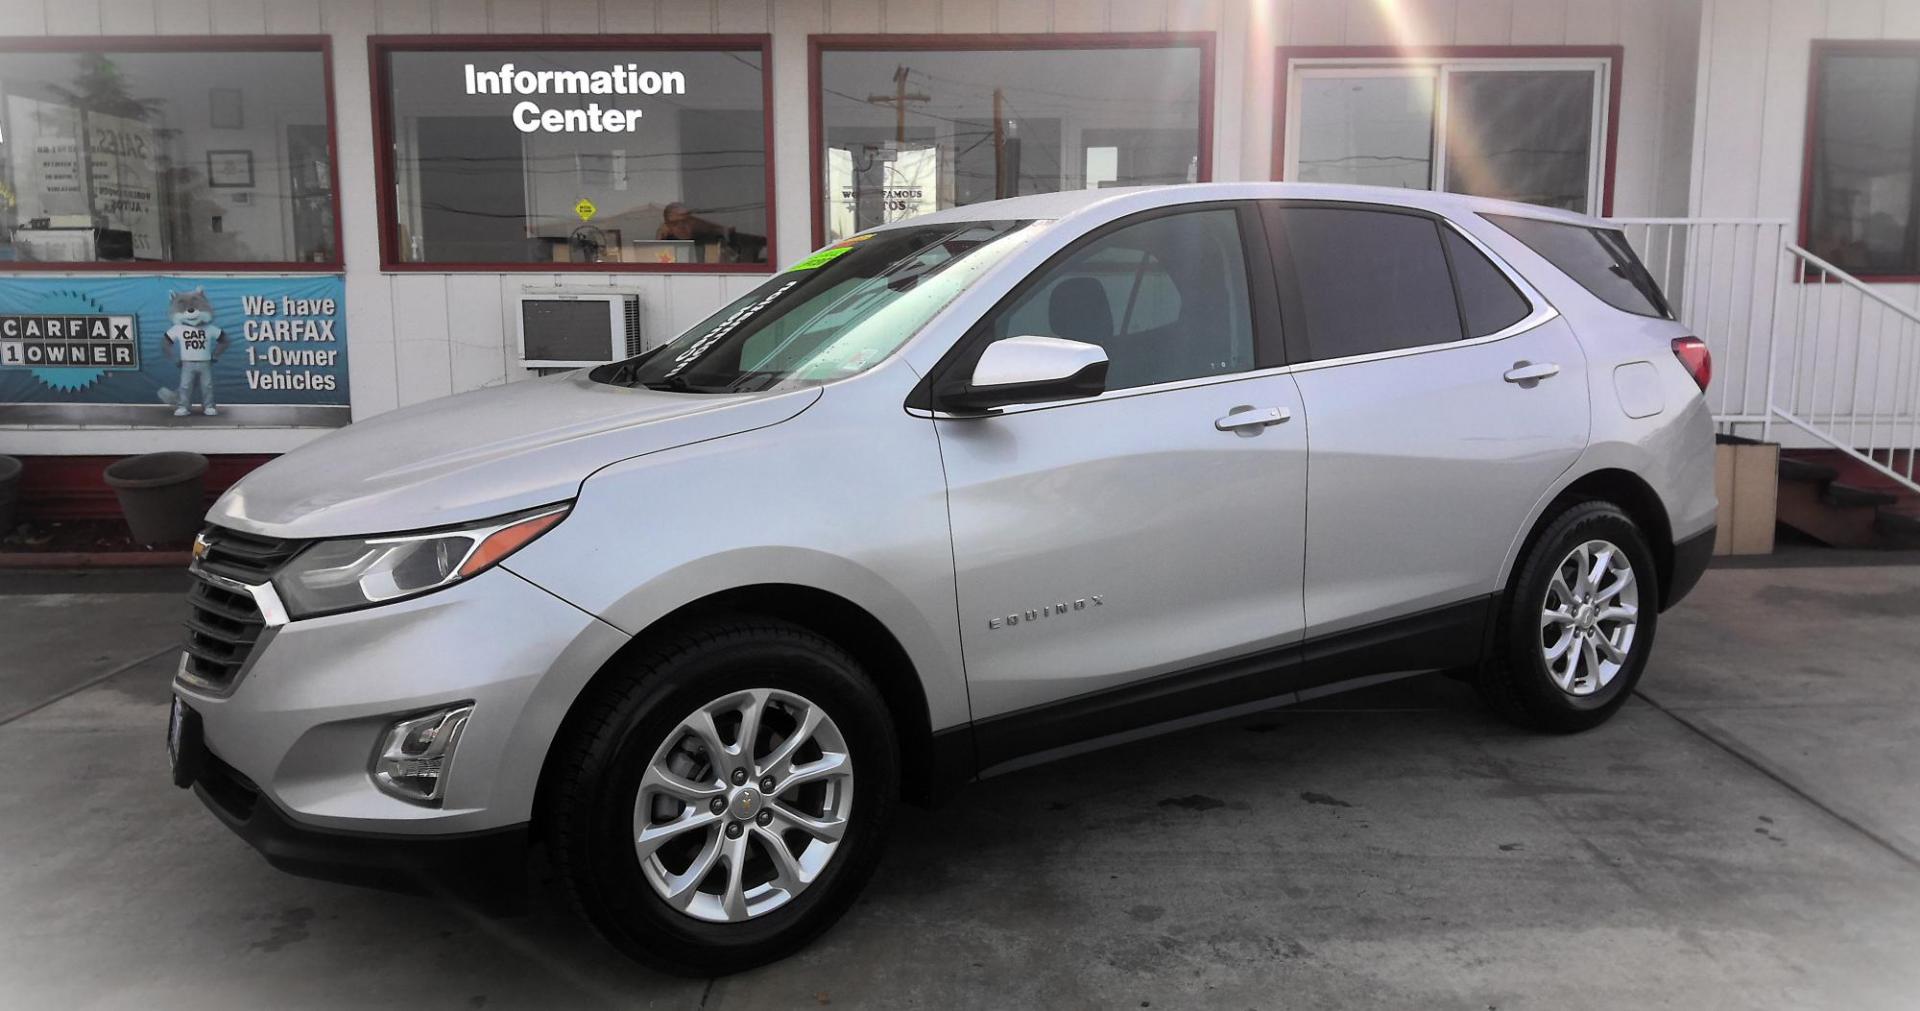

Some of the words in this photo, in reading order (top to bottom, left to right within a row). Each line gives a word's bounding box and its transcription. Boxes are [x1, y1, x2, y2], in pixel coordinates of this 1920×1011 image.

[464, 63, 686, 95] Information
[512, 101, 643, 133] Center
[242, 295, 276, 316] We
[282, 295, 335, 316] have
[3, 319, 129, 340] CARFAX
[182, 330, 206, 340] CAR
[243, 319, 336, 342] CARFAX
[7, 345, 19, 362] 1
[27, 346, 130, 363] OWNER
[185, 340, 206, 351] FOX
[245, 345, 337, 366] 1-Owner
[245, 370, 336, 390] Vehicles
[989, 594, 1104, 630] EQUINOX
